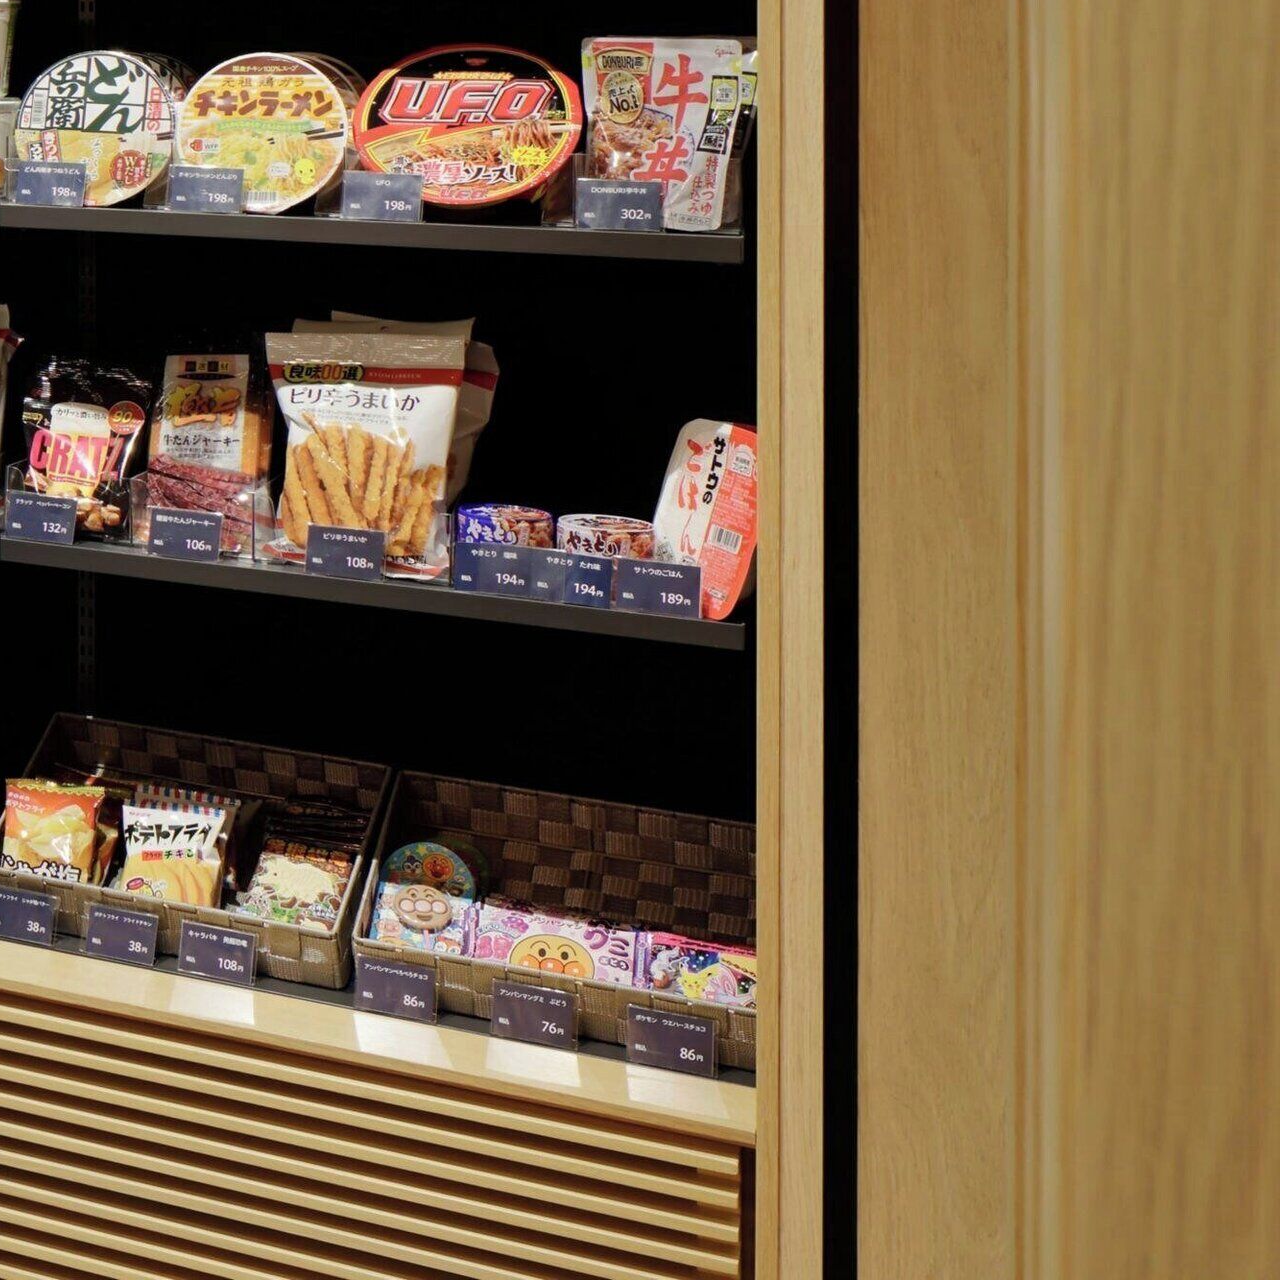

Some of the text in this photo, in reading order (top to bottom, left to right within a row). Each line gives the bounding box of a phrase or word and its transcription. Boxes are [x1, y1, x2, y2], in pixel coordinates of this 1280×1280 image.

[48, 60, 86, 131] 兵衛
[84, 56, 145, 134] どん
[194, 89, 334, 118] チキンラーメン
[633, 53, 709, 205] 牛丼
[375, 179, 392, 187] UFO
[51, 186, 77, 198] 198円
[207, 191, 235, 204] 198円
[383, 200, 413, 212] 198円
[620, 208, 652, 221] 302円
[289, 386, 421, 413] ピリ辛うまいか
[162, 433, 242, 448] 牛たんジャーキー
[28, 429, 126, 482] CRATZ
[42, 521, 68, 535] 132円
[322, 531, 369, 544] ピリ辛うまいか
[184, 538, 213, 553] 106円
[470, 548, 498, 560] やきとり
[345, 555, 375, 570] 108円
[545, 555, 602, 572] やきとり たれ味
[494, 571, 526, 587] 194円
[633, 565, 684, 580] サトウのごはん
[572, 581, 605, 599] 194円
[659, 590, 692, 608] 189円
[123, 820, 213, 848] ポテトフライ
[25, 919, 47, 934] 38円
[127, 939, 149, 954] 38円
[217, 956, 245, 973] 108円
[402, 993, 426, 1009] 86円
[548, 997, 569, 1009] ぶどう
[541, 1019, 565, 1036] 76円
[678, 1046, 705, 1063] 86円
